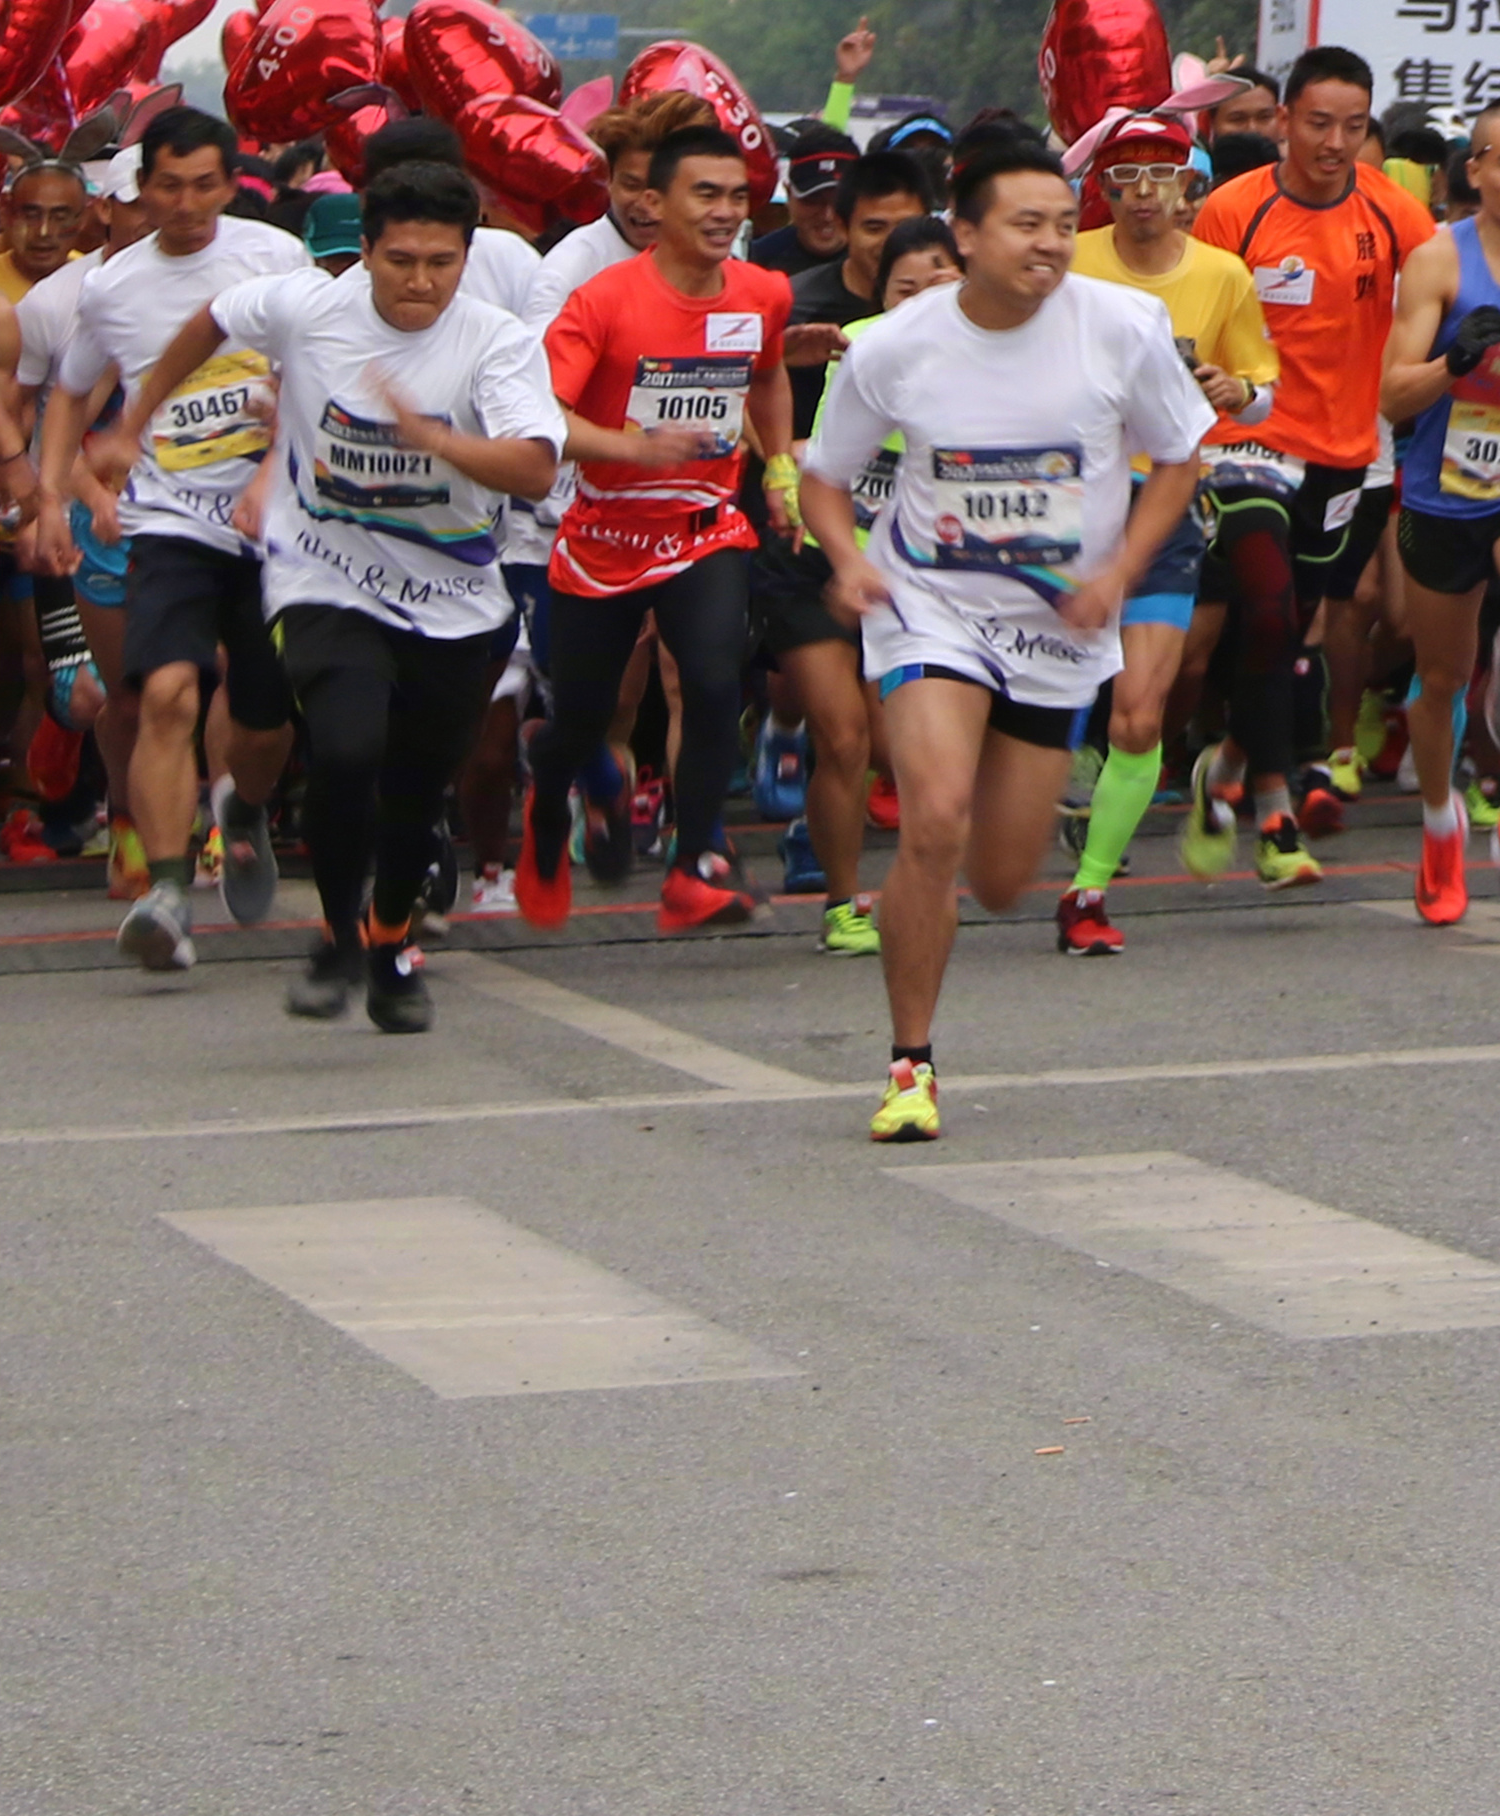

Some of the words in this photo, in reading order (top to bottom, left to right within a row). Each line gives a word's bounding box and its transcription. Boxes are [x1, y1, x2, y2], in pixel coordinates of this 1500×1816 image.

[257, 5, 315, 81] 4:00
[703, 70, 764, 152] 5:30
[170, 387, 252, 429] 30467
[655, 395, 729, 422] 10105
[330, 442, 433, 477] MM10021
[963, 490, 1049, 520] 10142
[399, 575, 486, 606] Muse
